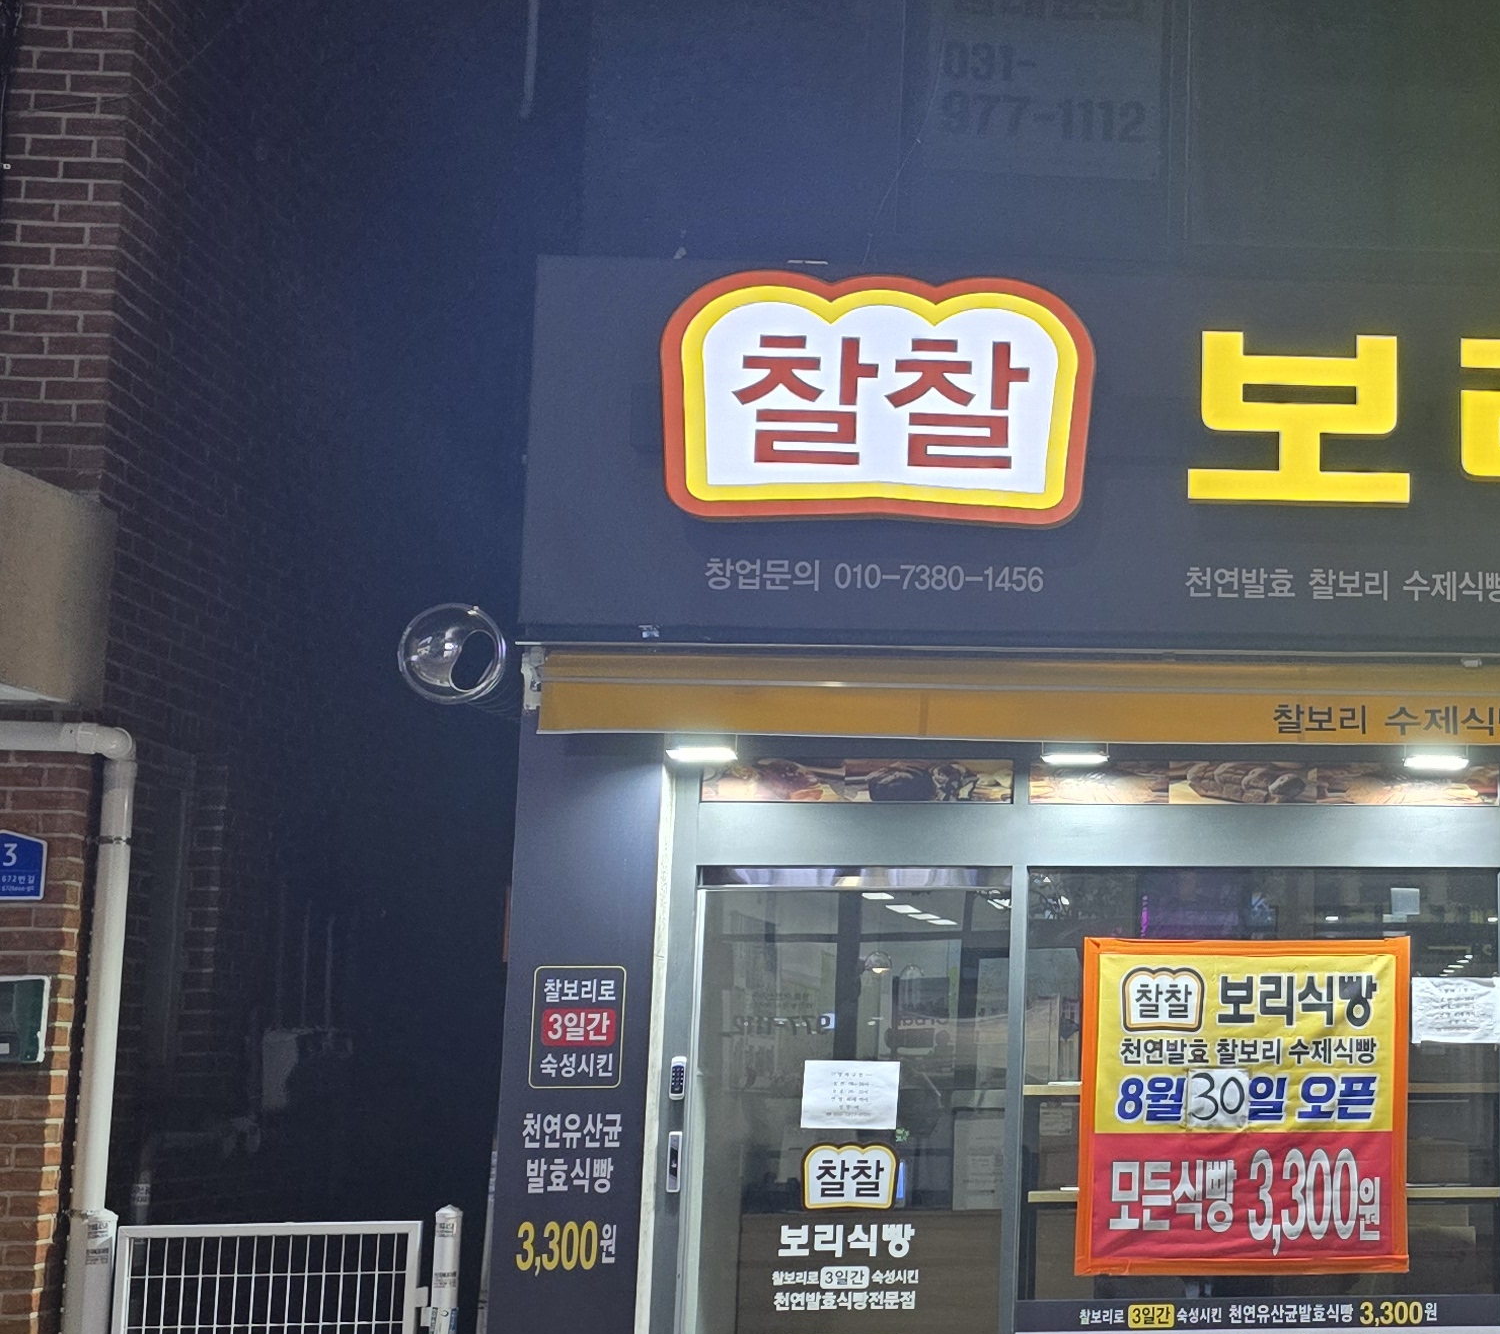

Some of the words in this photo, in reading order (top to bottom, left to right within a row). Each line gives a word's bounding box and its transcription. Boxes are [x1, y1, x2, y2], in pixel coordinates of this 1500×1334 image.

[732, 334, 1030, 469] 찰찰
[705, 557, 821, 593] 창업문의
[834, 563, 1044, 595] 010-7380-1456
[1184, 565, 1296, 602] 천연발효
[1308, 568, 1391, 603] 찰보리
[1272, 702, 1369, 737] 찰보리
[543, 978, 616, 1003] 찰보리로
[1134, 983, 1192, 1019] 찰찰
[1217, 975, 1377, 1027] 보리식빵
[547, 1012, 611, 1042] 3일간
[540, 1052, 613, 1078] 숙성시킨
[1120, 1038, 1209, 1066] 천연발효
[1216, 1038, 1281, 1064] 찰보리
[1288, 1038, 1377, 1064] 수제식빵
[1297, 1076, 1377, 1122] 오픈
[522, 1113, 623, 1149] 천연유산균
[526, 1157, 614, 1194] 발효식빵
[815, 1159, 884, 1198] 찰찰
[1109, 1159, 1237, 1233] 모든식빵
[778, 1223, 916, 1259] 보리식빵
[772, 1270, 819, 1286] 찰보리로
[824, 1270, 864, 1285] 3일간
[871, 1269, 919, 1285] 숙성시킨
[773, 1290, 916, 1312] 천연발효식빵전문점
[1079, 1309, 1125, 1324] 찰보리로
[1131, 1307, 1170, 1325] 3일간
[1176, 1307, 1222, 1323] 숙성시킨
